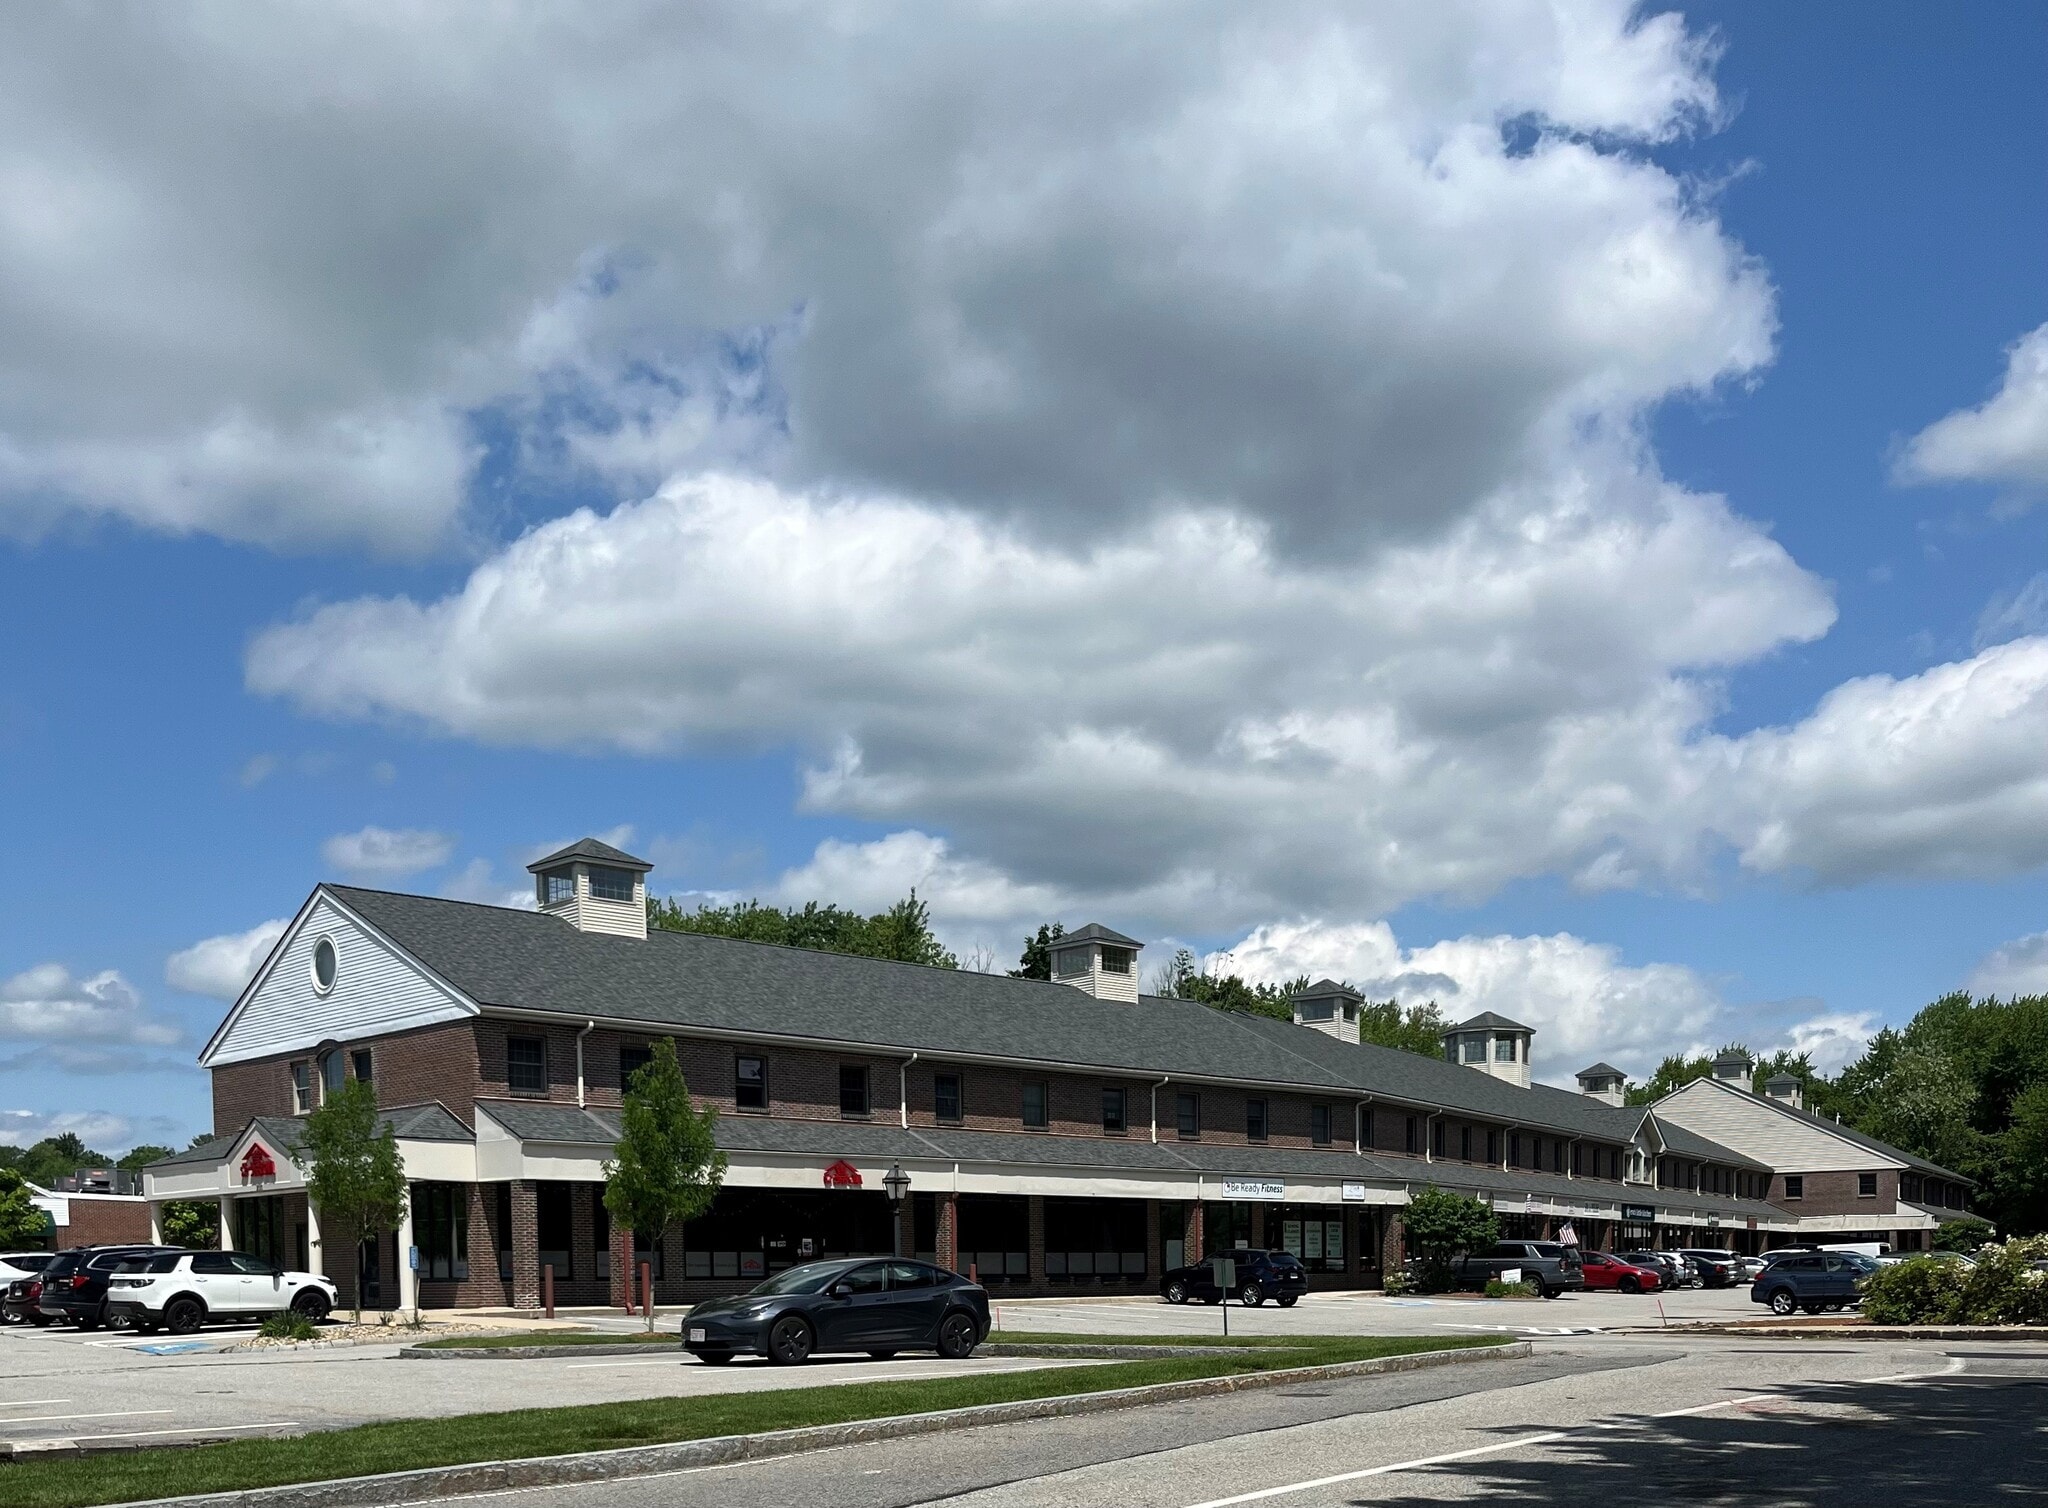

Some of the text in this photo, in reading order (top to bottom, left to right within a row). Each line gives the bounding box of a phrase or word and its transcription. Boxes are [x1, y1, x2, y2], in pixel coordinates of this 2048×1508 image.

[1231, 1182, 1283, 1194] Be Ready Fitness
